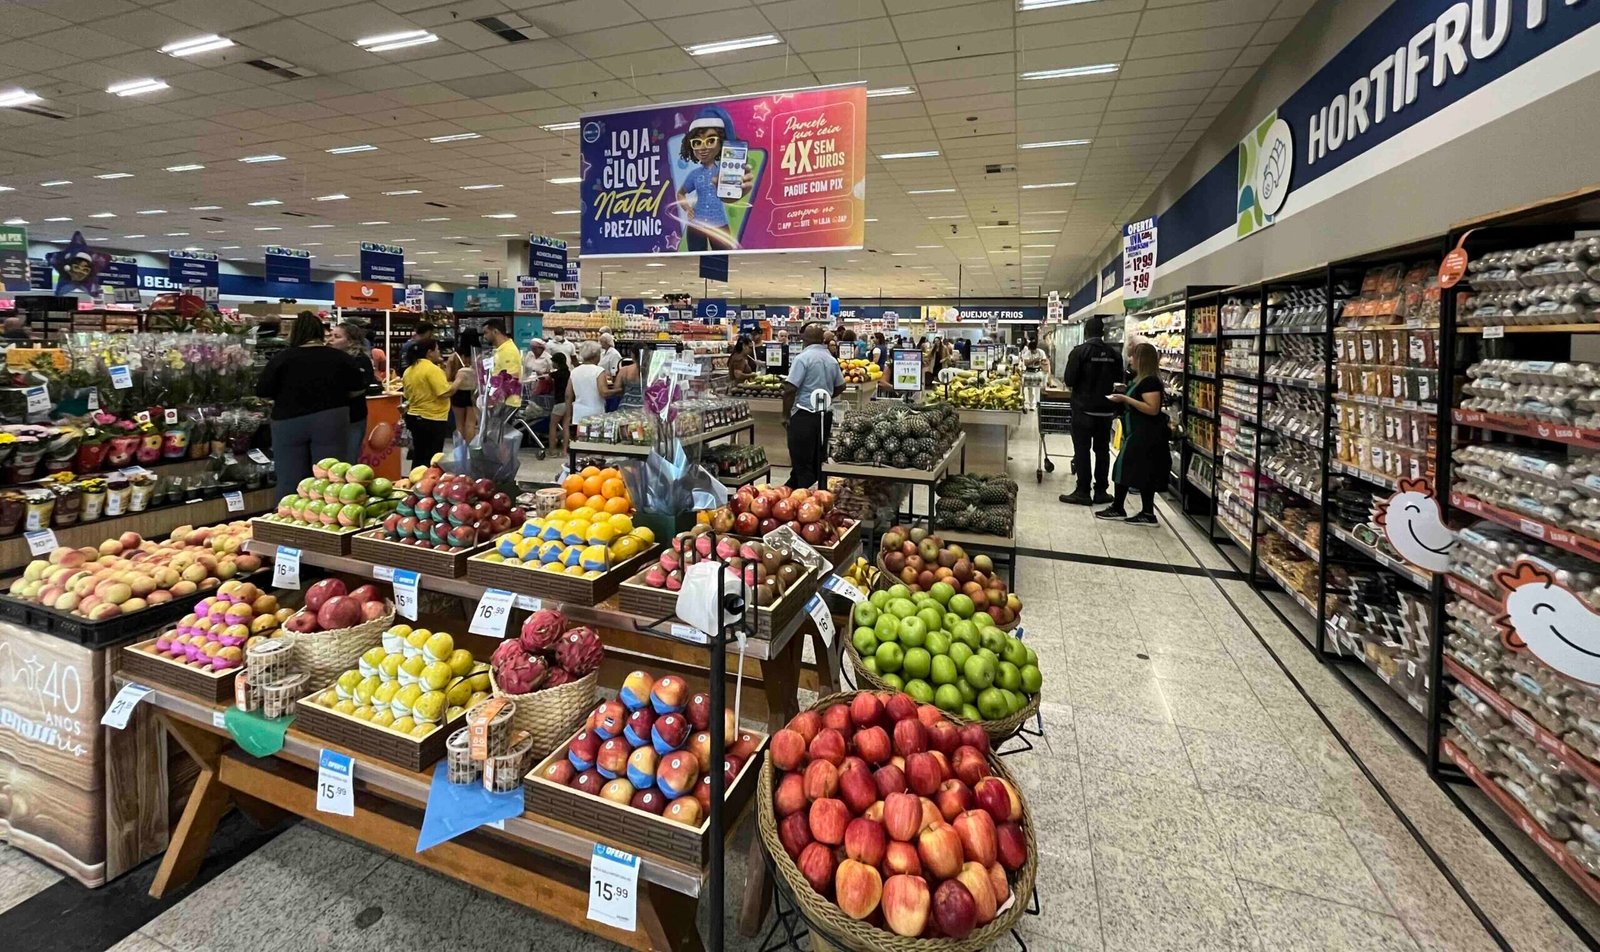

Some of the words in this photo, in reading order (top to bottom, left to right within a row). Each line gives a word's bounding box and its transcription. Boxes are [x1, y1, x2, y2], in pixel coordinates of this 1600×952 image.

[1308, 0, 1582, 165] HORTIFRU
[783, 113, 827, 135] Parcele
[612, 128, 650, 160] LOJA
[813, 138, 835, 155] SEM
[781, 139, 813, 175] 4X
[813, 151, 845, 170] JUROS
[603, 155, 660, 189] CLIQUE
[784, 182, 808, 197] PAGUE
[810, 179, 828, 193] COM
[830, 177, 843, 191] PIX
[593, 180, 670, 221] Natal
[604, 216, 662, 238] PREZUNIC
[1128, 218, 1153, 234] OFERTA
[143, 275, 184, 289] BEB
[960, 311, 993, 319] QUEIJOS
[1001, 311, 1023, 319] FRIOS
[43, 662, 81, 713] 40
[45, 711, 81, 735] ANOS
[606, 846, 633, 863] OFERTA
